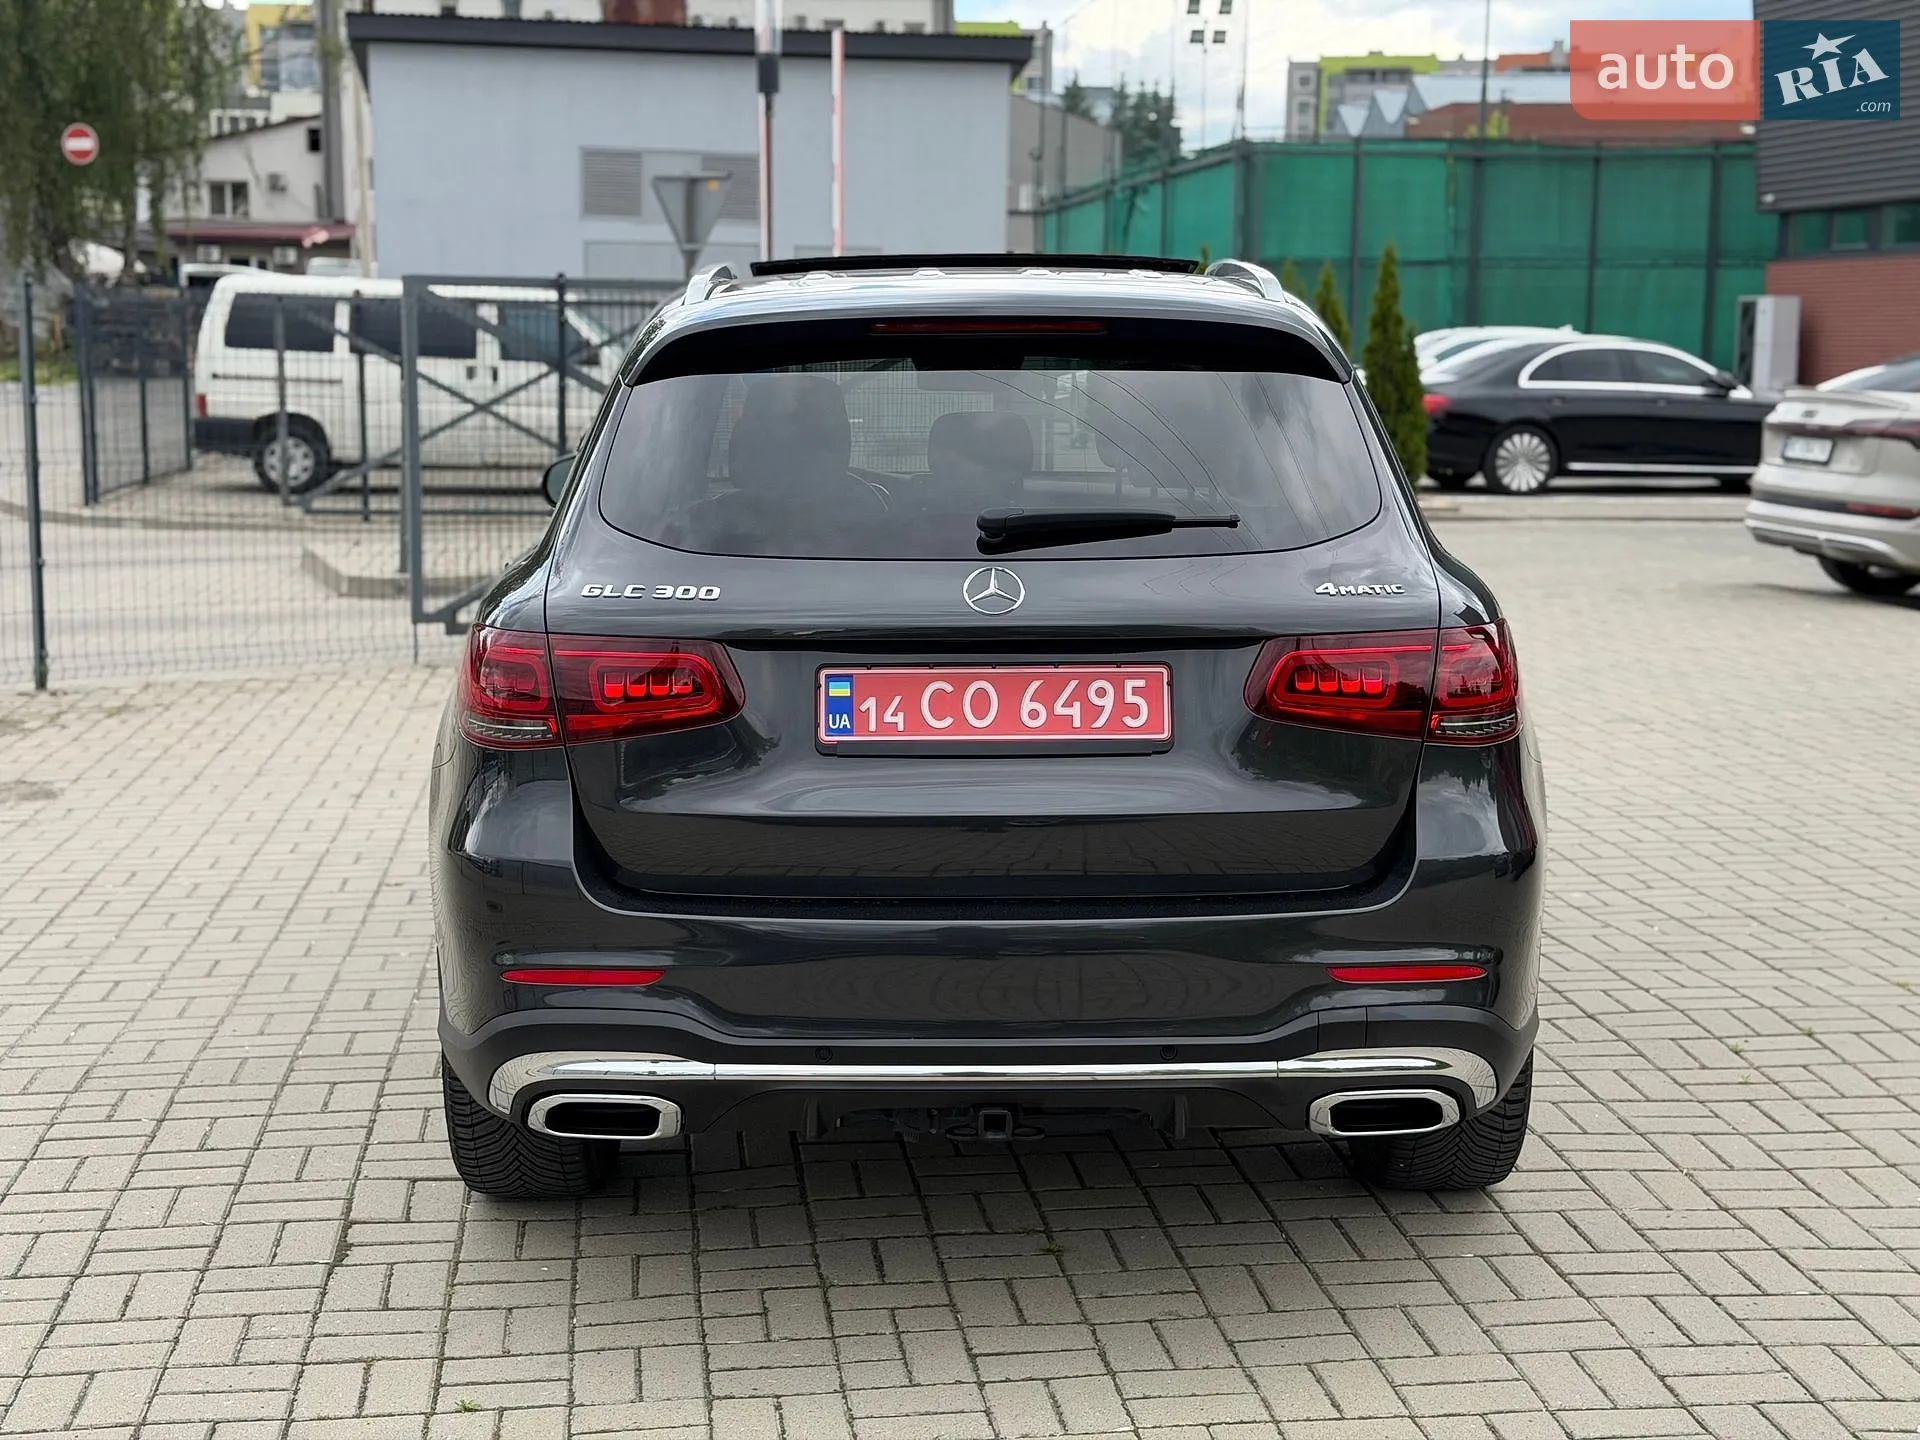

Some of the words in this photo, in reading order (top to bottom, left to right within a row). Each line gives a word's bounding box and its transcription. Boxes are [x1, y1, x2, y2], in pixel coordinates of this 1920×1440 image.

[580, 583, 646, 599] GLC
[652, 584, 721, 601] 300
[1314, 582, 1406, 597] 4MATIC
[858, 695, 905, 732] 14
[919, 679, 999, 729] CO
[1019, 678, 1149, 729] 6495
[828, 713, 851, 730] UA
